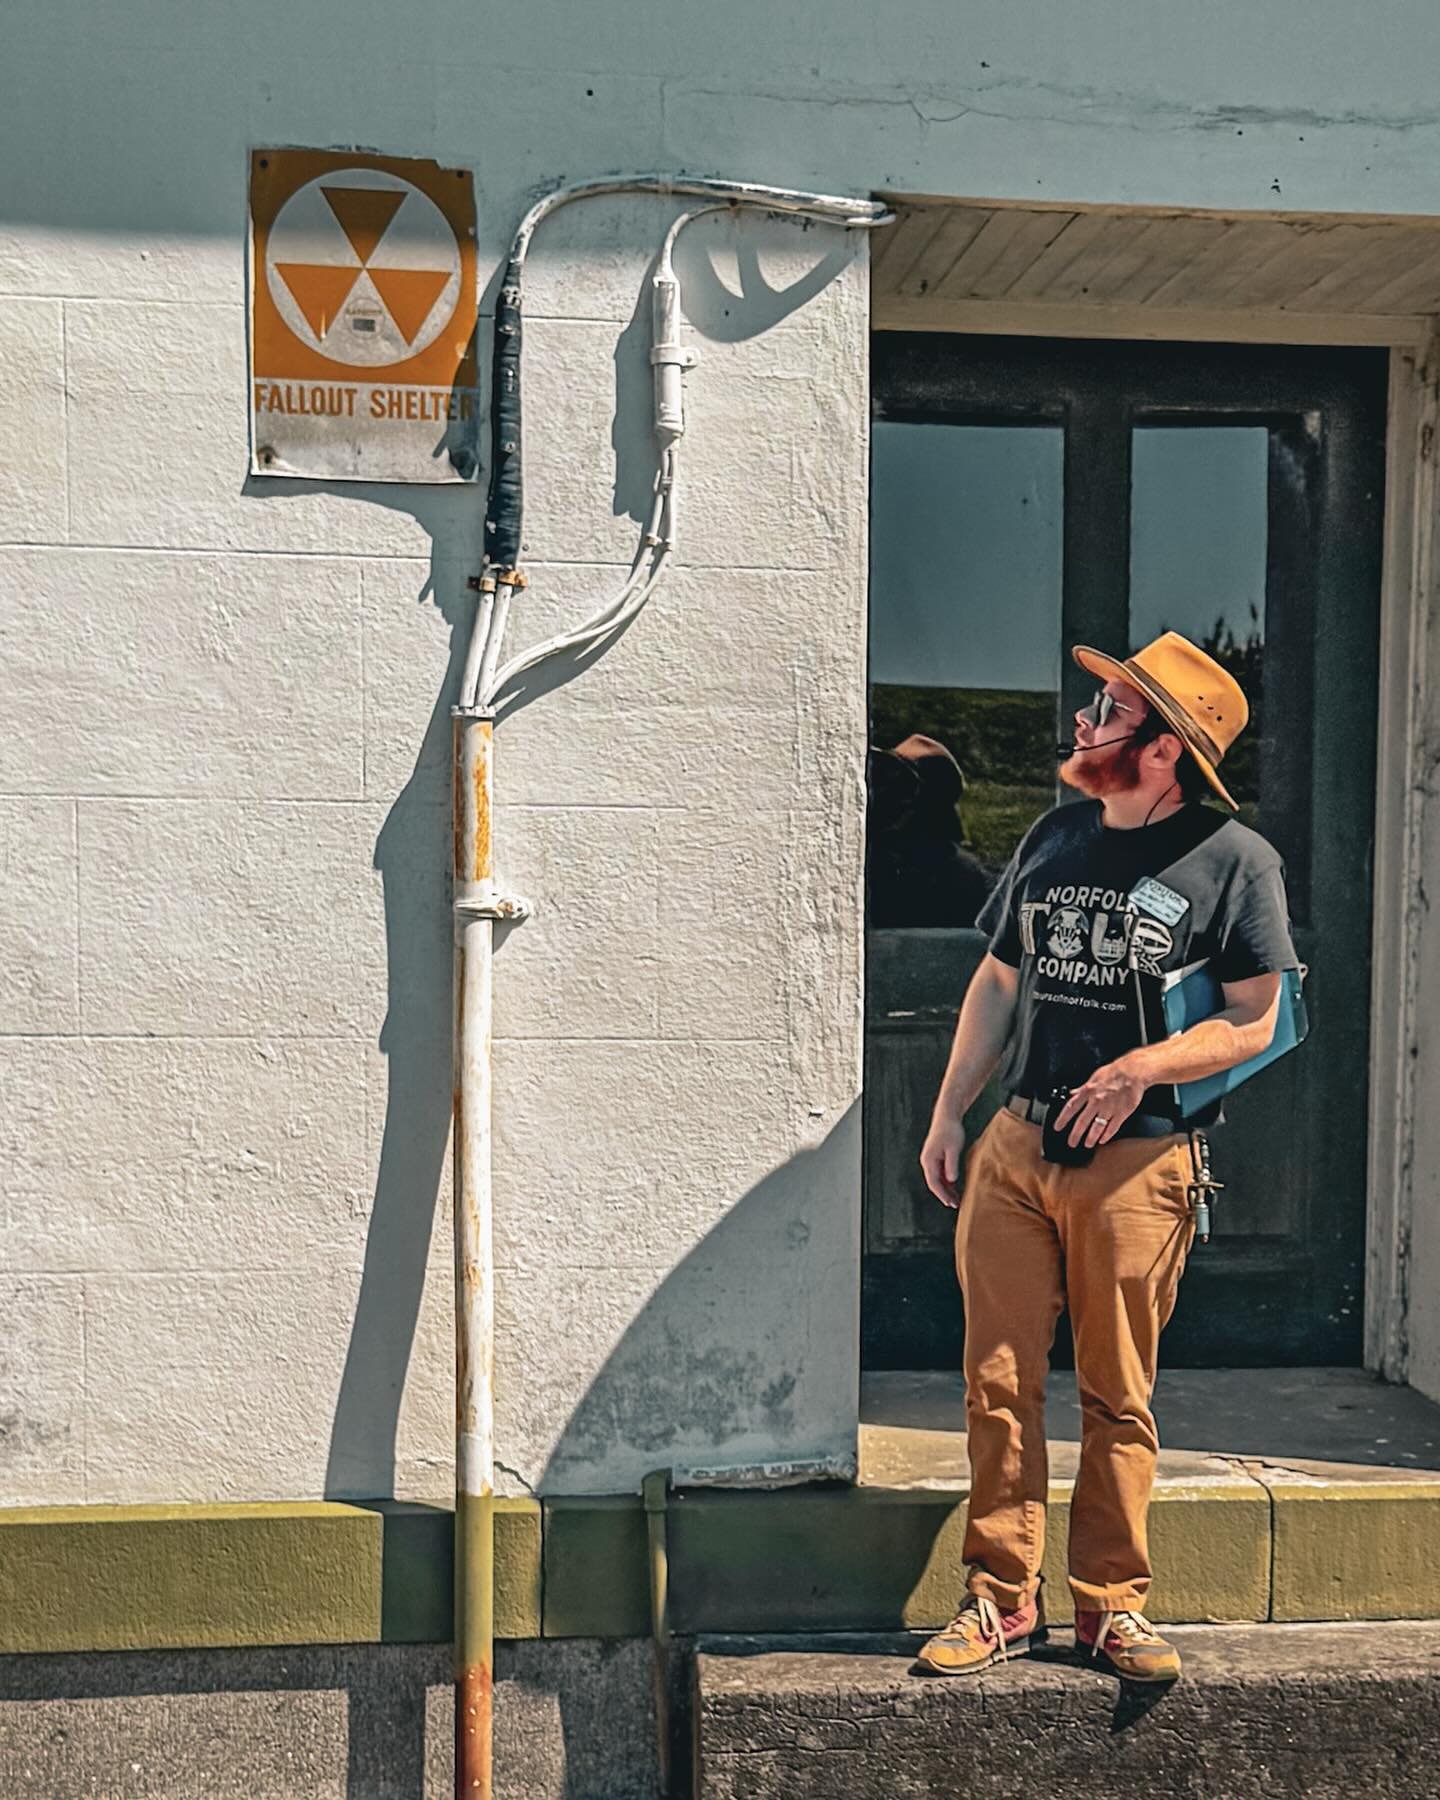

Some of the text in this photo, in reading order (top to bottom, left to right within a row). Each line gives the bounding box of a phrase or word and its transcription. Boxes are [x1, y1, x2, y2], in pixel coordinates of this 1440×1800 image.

[255, 384, 474, 422] FALLOUT SHELTER
[1019, 902, 1174, 980] TOUR
[1037, 956, 1130, 986] COMPANY
